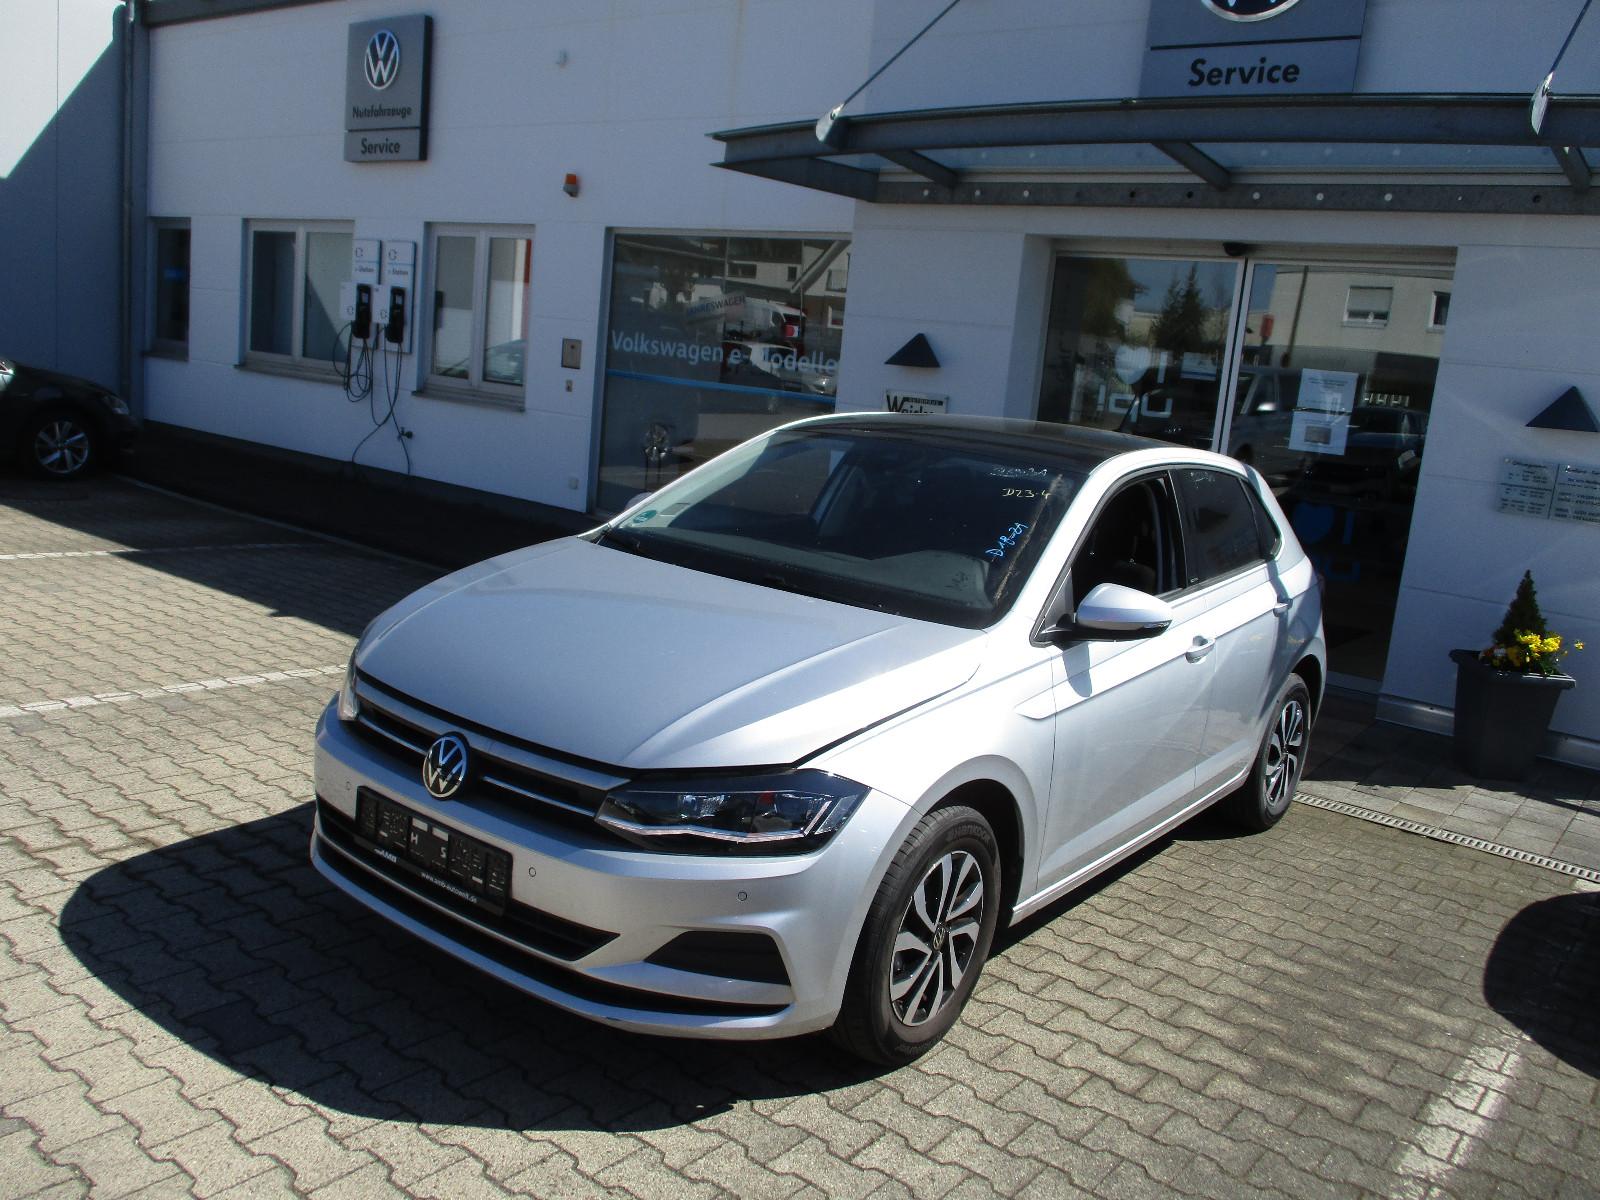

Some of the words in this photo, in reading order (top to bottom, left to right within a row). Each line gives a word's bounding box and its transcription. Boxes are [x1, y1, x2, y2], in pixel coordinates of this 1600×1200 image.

[1188, 57, 1301, 88] Service
[352, 104, 412, 119] Nutzfahrzeuge
[360, 137, 401, 155] Service
[612, 329, 724, 365] Volkswagen
